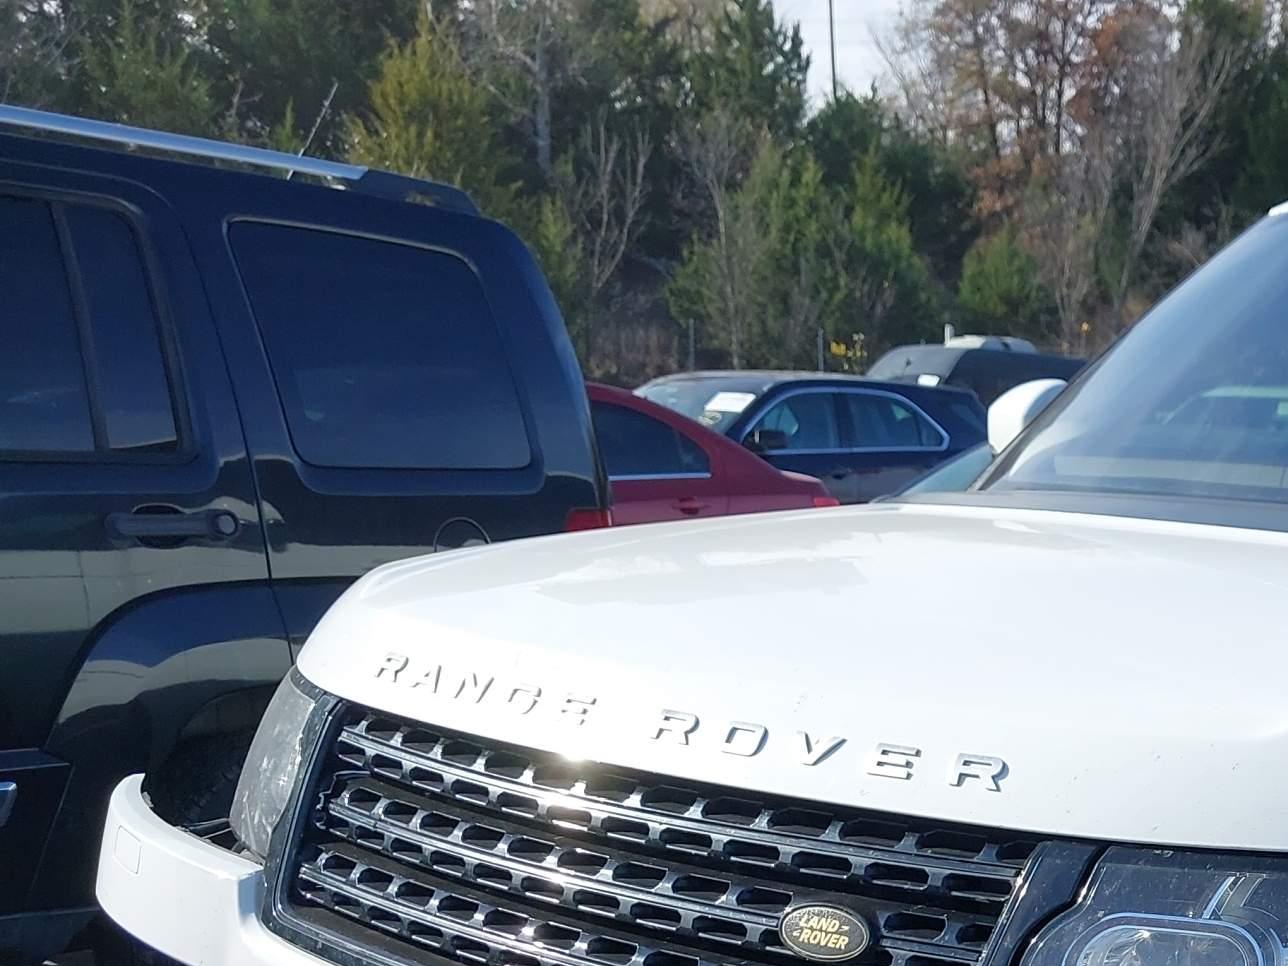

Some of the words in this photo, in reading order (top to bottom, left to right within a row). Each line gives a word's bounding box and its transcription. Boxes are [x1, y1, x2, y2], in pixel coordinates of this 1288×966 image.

[374, 651, 598, 727] RANGE
[650, 708, 1010, 793] ROVER
[799, 913, 840, 933] LAND
[798, 928, 849, 950] ROVER
